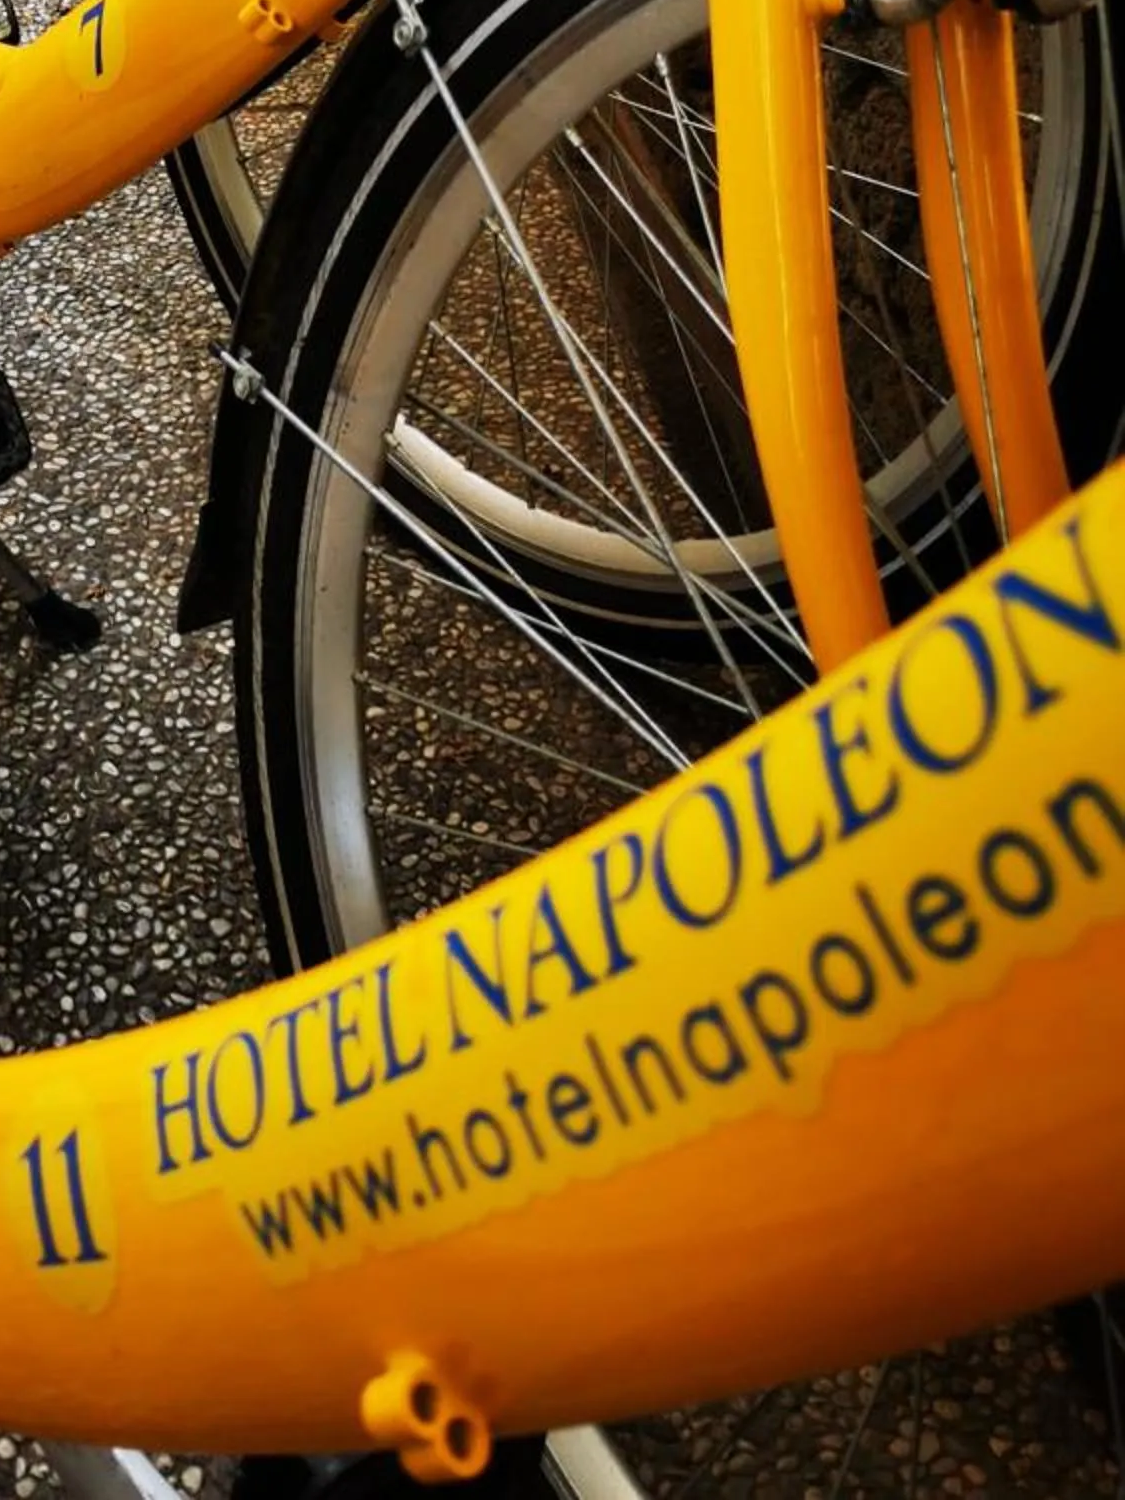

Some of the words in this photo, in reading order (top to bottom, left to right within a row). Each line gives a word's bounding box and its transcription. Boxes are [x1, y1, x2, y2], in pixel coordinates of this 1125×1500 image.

[151, 963, 428, 1175] HOTEL
[443, 507, 1123, 1053] NAPOLEON
[20, 1126, 109, 1267] 11
